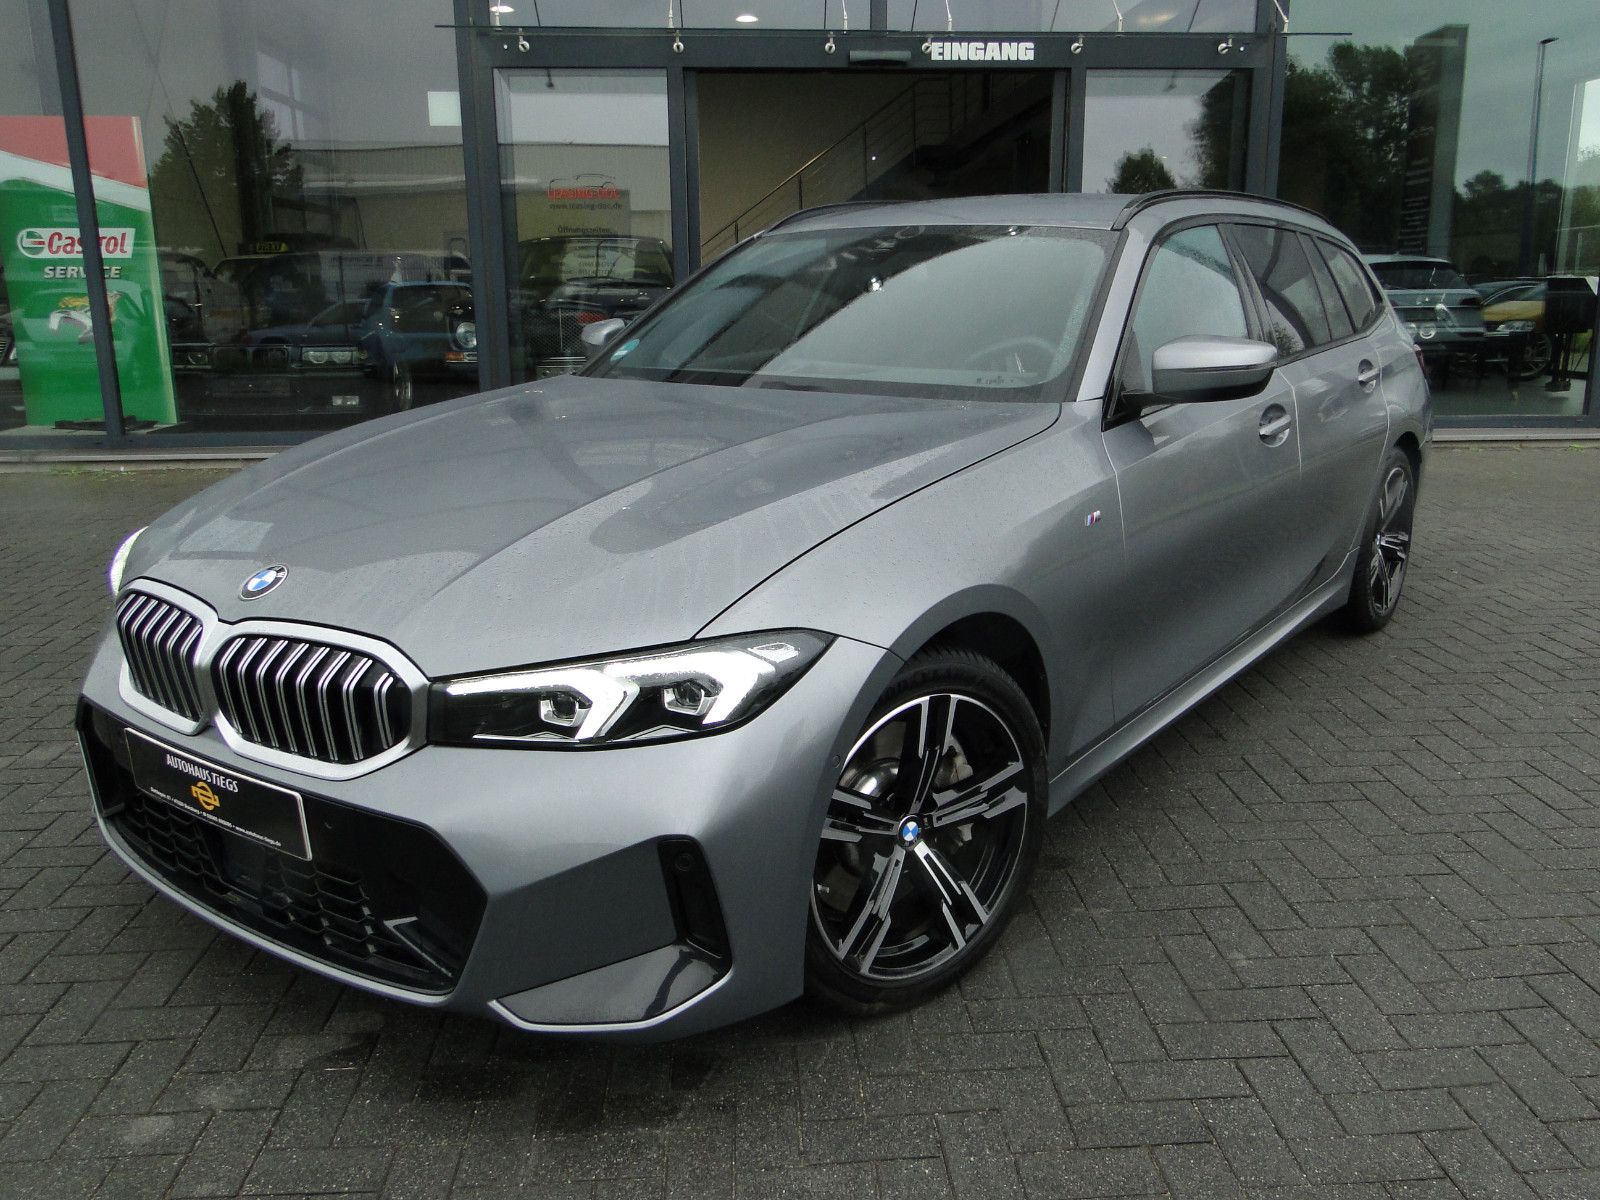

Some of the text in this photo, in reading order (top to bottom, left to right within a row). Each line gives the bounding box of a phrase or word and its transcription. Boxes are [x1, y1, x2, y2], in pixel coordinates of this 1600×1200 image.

[930, 42, 1035, 61] EINGANG
[47, 231, 128, 255] Carol
[44, 266, 122, 279] SERVE
[166, 753, 212, 783] AUTOHAUS
